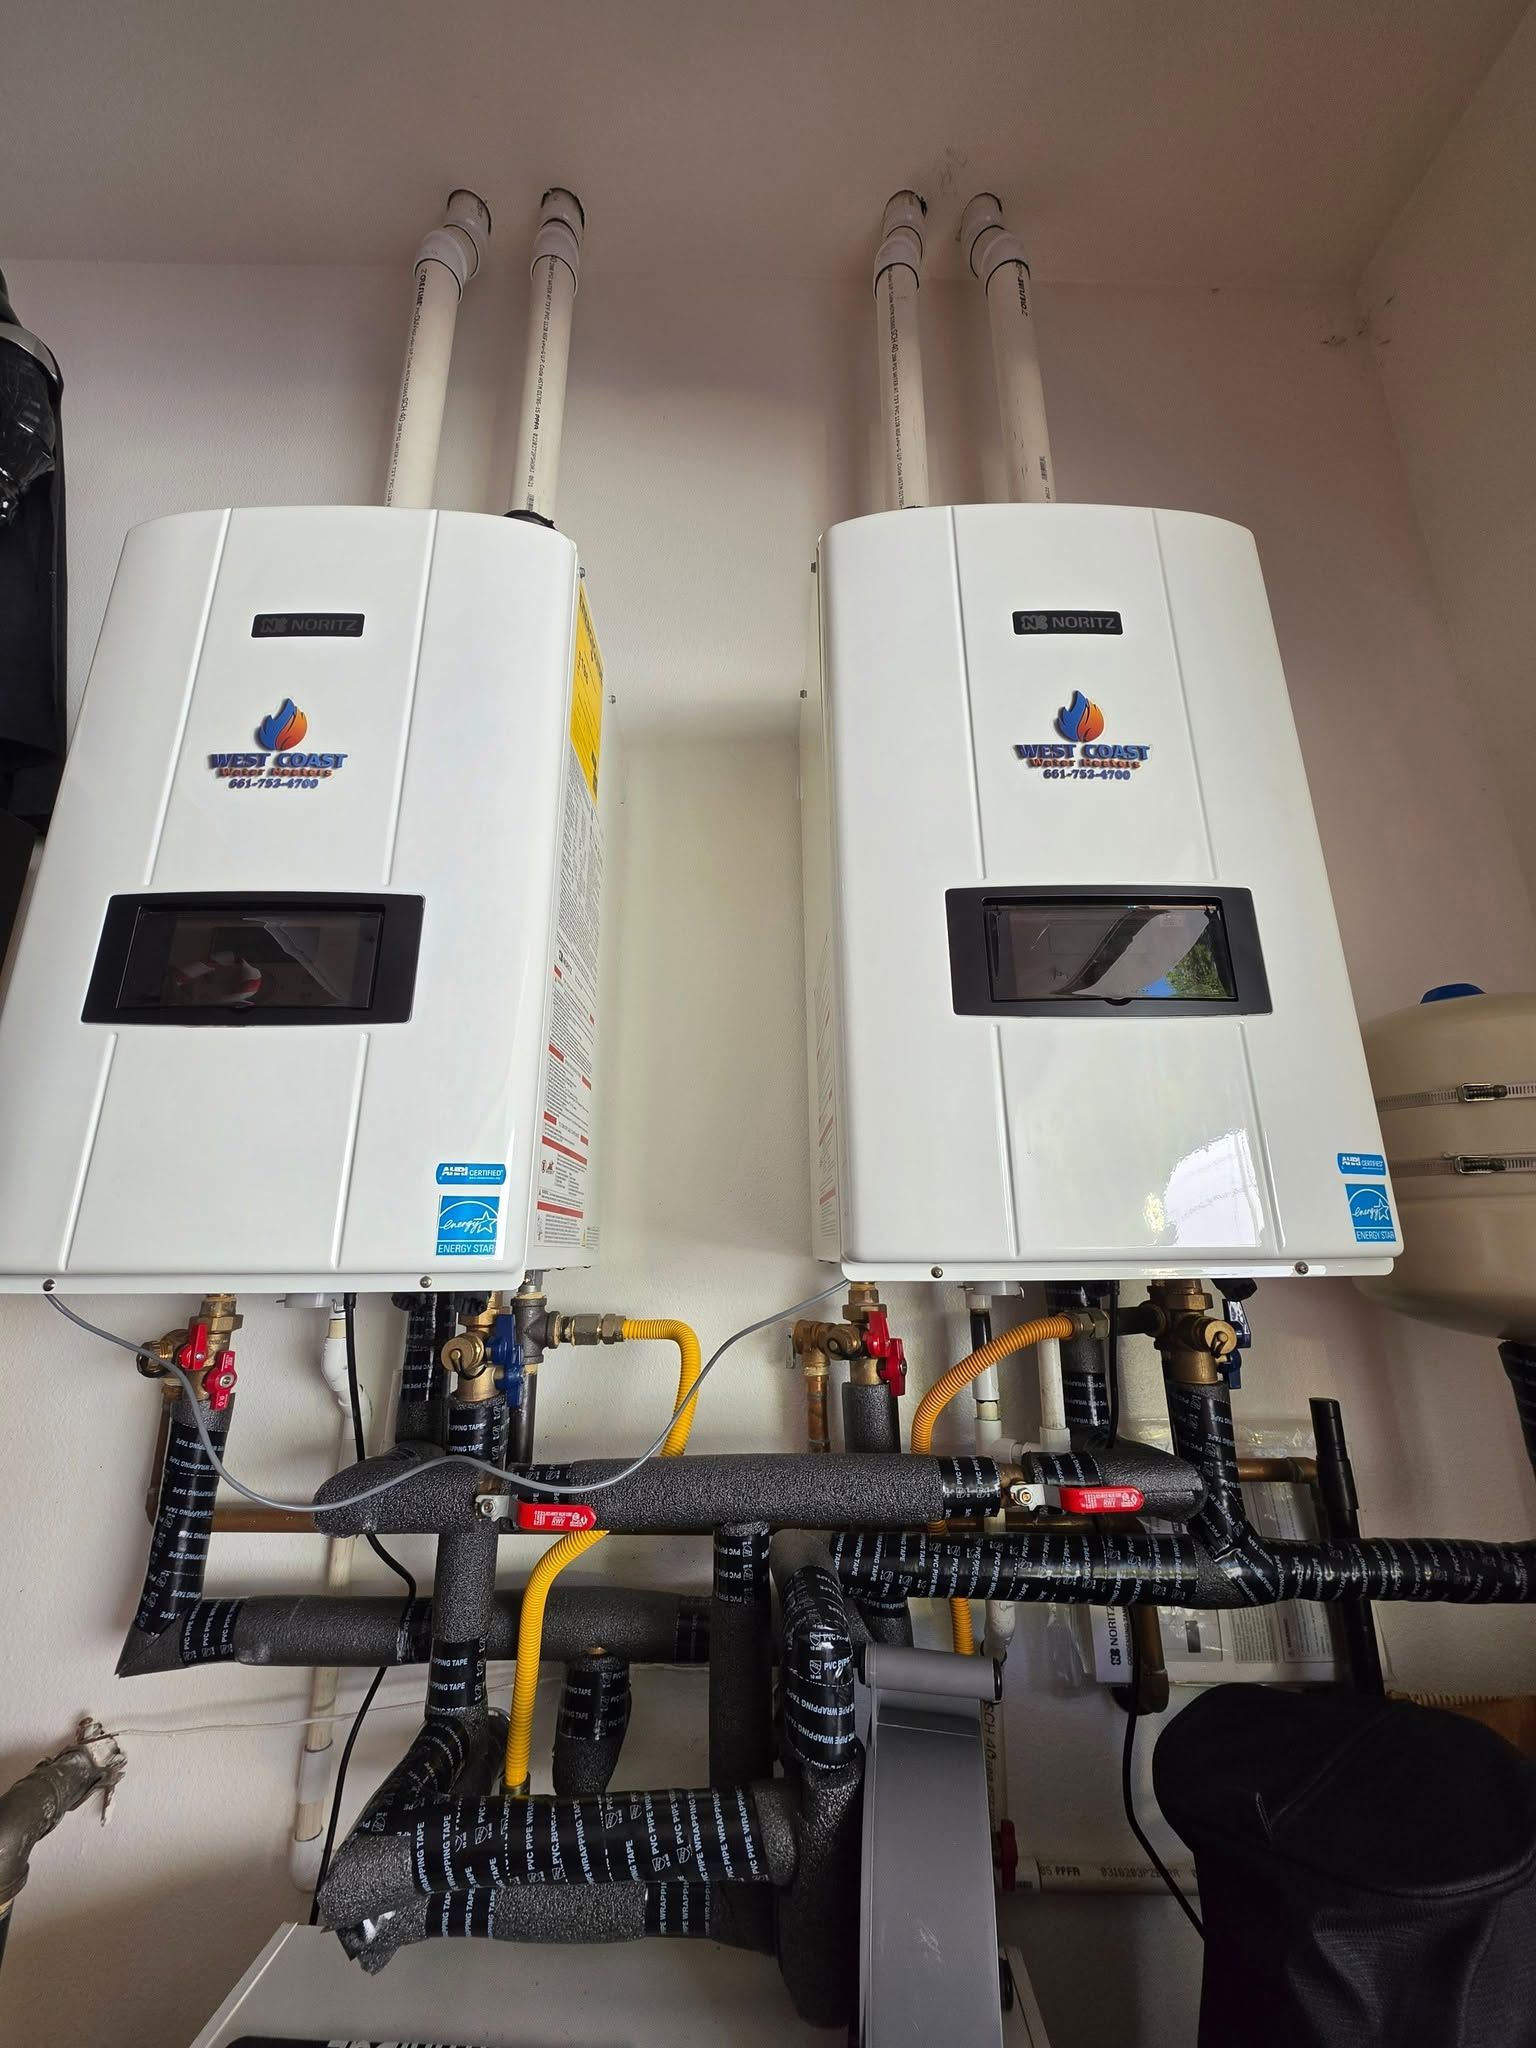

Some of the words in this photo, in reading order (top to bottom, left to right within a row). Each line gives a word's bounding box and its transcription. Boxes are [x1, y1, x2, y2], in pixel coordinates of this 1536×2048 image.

[291, 619, 358, 632] NORITZ
[1052, 616, 1117, 629] NORITZ
[210, 753, 270, 768] WEST
[274, 753, 348, 768] COAST
[1016, 744, 1076, 759] WEST
[1081, 744, 1150, 760] COAST
[1357, 1231, 1380, 1239] ENERGY
[438, 1245, 472, 1253] ENERGY
[172, 1487, 187, 1495] TAPE
[168, 1551, 183, 1559] TAPE
[851, 1559, 860, 1576] TAPE
[870, 1565, 879, 1582] TAPE
[171, 1590, 186, 1598] TAPE
[160, 1611, 176, 1619] TAPE
[1107, 1606, 1118, 1646] NORITZ
[452, 1658, 468, 1666] TAPE
[824, 1661, 837, 1670] PVC
[449, 1682, 465, 1691] TAPE
[578, 1687, 592, 1696] TAPE
[801, 1699, 837, 1715] WRAPPING
[797, 1724, 834, 1744] WRAPPING
[478, 1806, 486, 1823] PVC
[573, 1799, 582, 1818] TAPE
[671, 1802, 680, 1822] PIPE
[712, 1792, 727, 1841] WRAPPING
[443, 1814, 452, 1840] TAPE
[646, 1811, 656, 1832] PIPE
[688, 1798, 702, 1851] WRAPPING
[417, 1821, 425, 1848] TAPE
[526, 1826, 534, 1850] PIPE
[674, 1824, 685, 1844] PVC
[575, 1819, 592, 1872] WRAPPING
[625, 1840, 636, 1863] TAPE
[650, 1834, 660, 1855] PVC
[720, 1843, 731, 1865] PIPE
[745, 1835, 756, 1858] PIPE
[417, 1849, 433, 1892] WRAPPING
[443, 1841, 457, 1887] WRAPPING
[489, 1857, 501, 1878] TAPE
[527, 1852, 535, 1870] PVC
[697, 1853, 707, 1871] PIPE
[750, 1859, 759, 1874] PVC
[464, 1865, 478, 1885] TAPE
[466, 1888, 476, 1910] TAPE
[489, 1888, 497, 1912] TAPE
